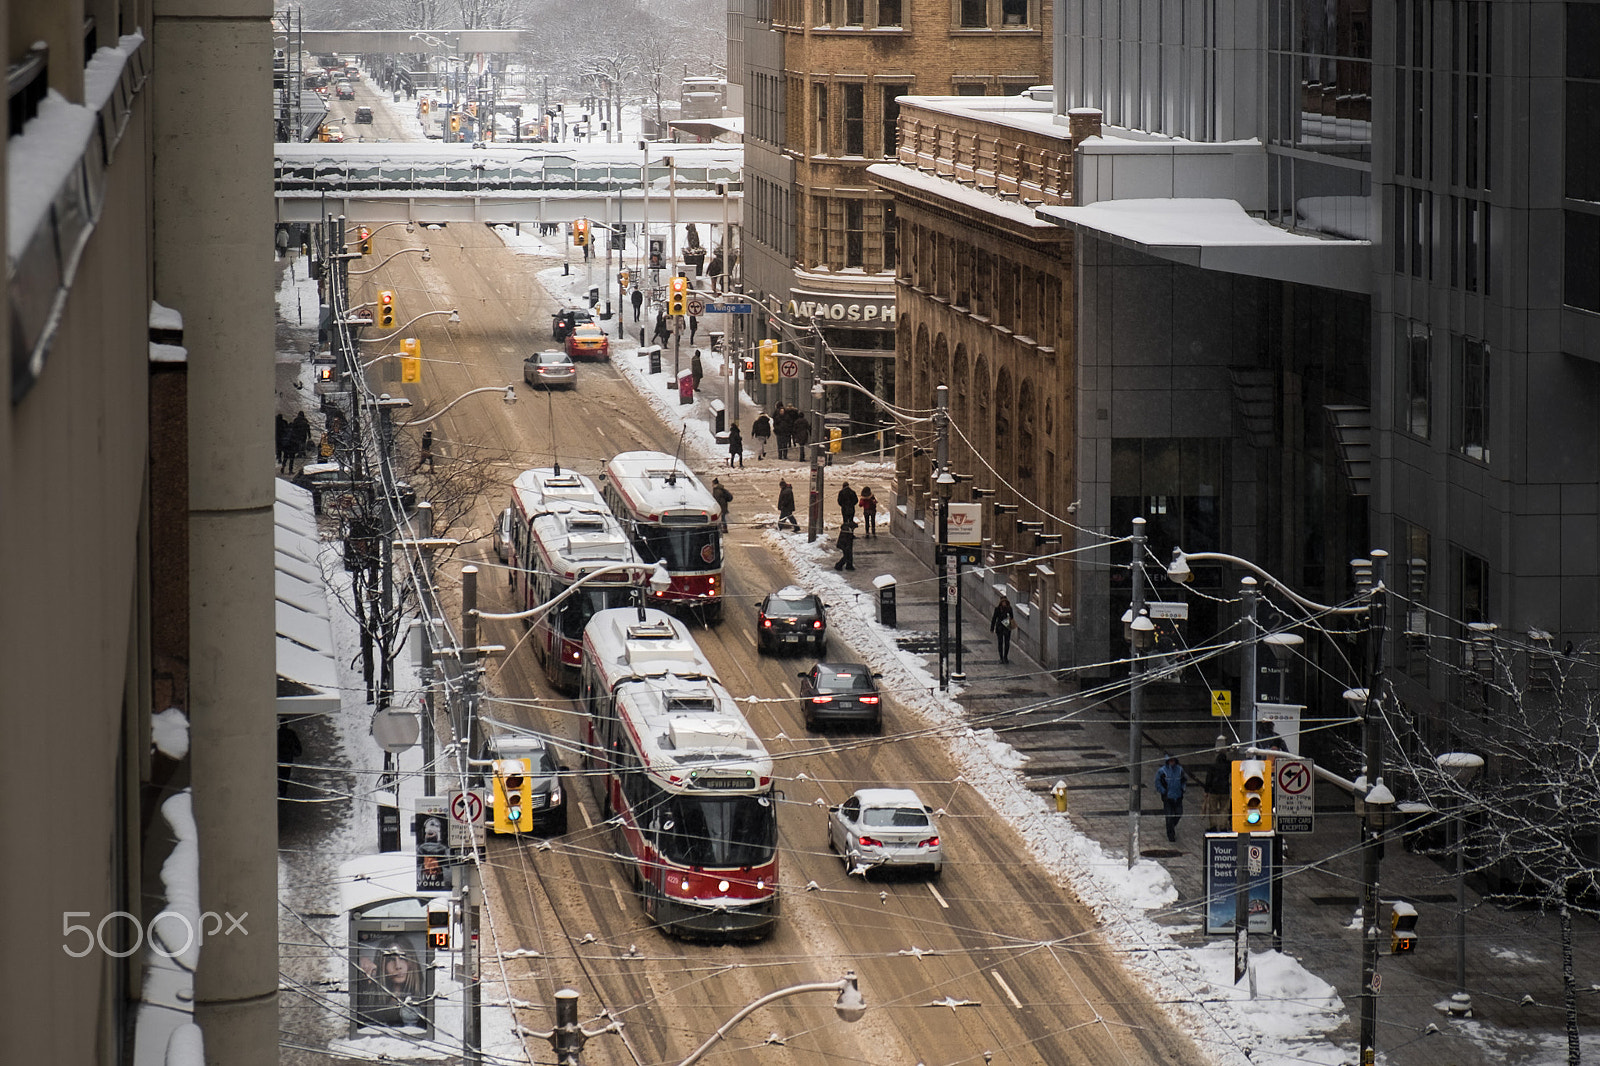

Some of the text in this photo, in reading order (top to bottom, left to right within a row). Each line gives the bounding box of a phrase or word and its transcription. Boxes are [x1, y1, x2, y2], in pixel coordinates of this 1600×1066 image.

[713, 303, 736, 314] Yonge
[1214, 846, 1231, 855] Your
[1214, 869, 1232, 877] best
[436, 933, 446, 945] 13
[1400, 937, 1410, 950] 13
